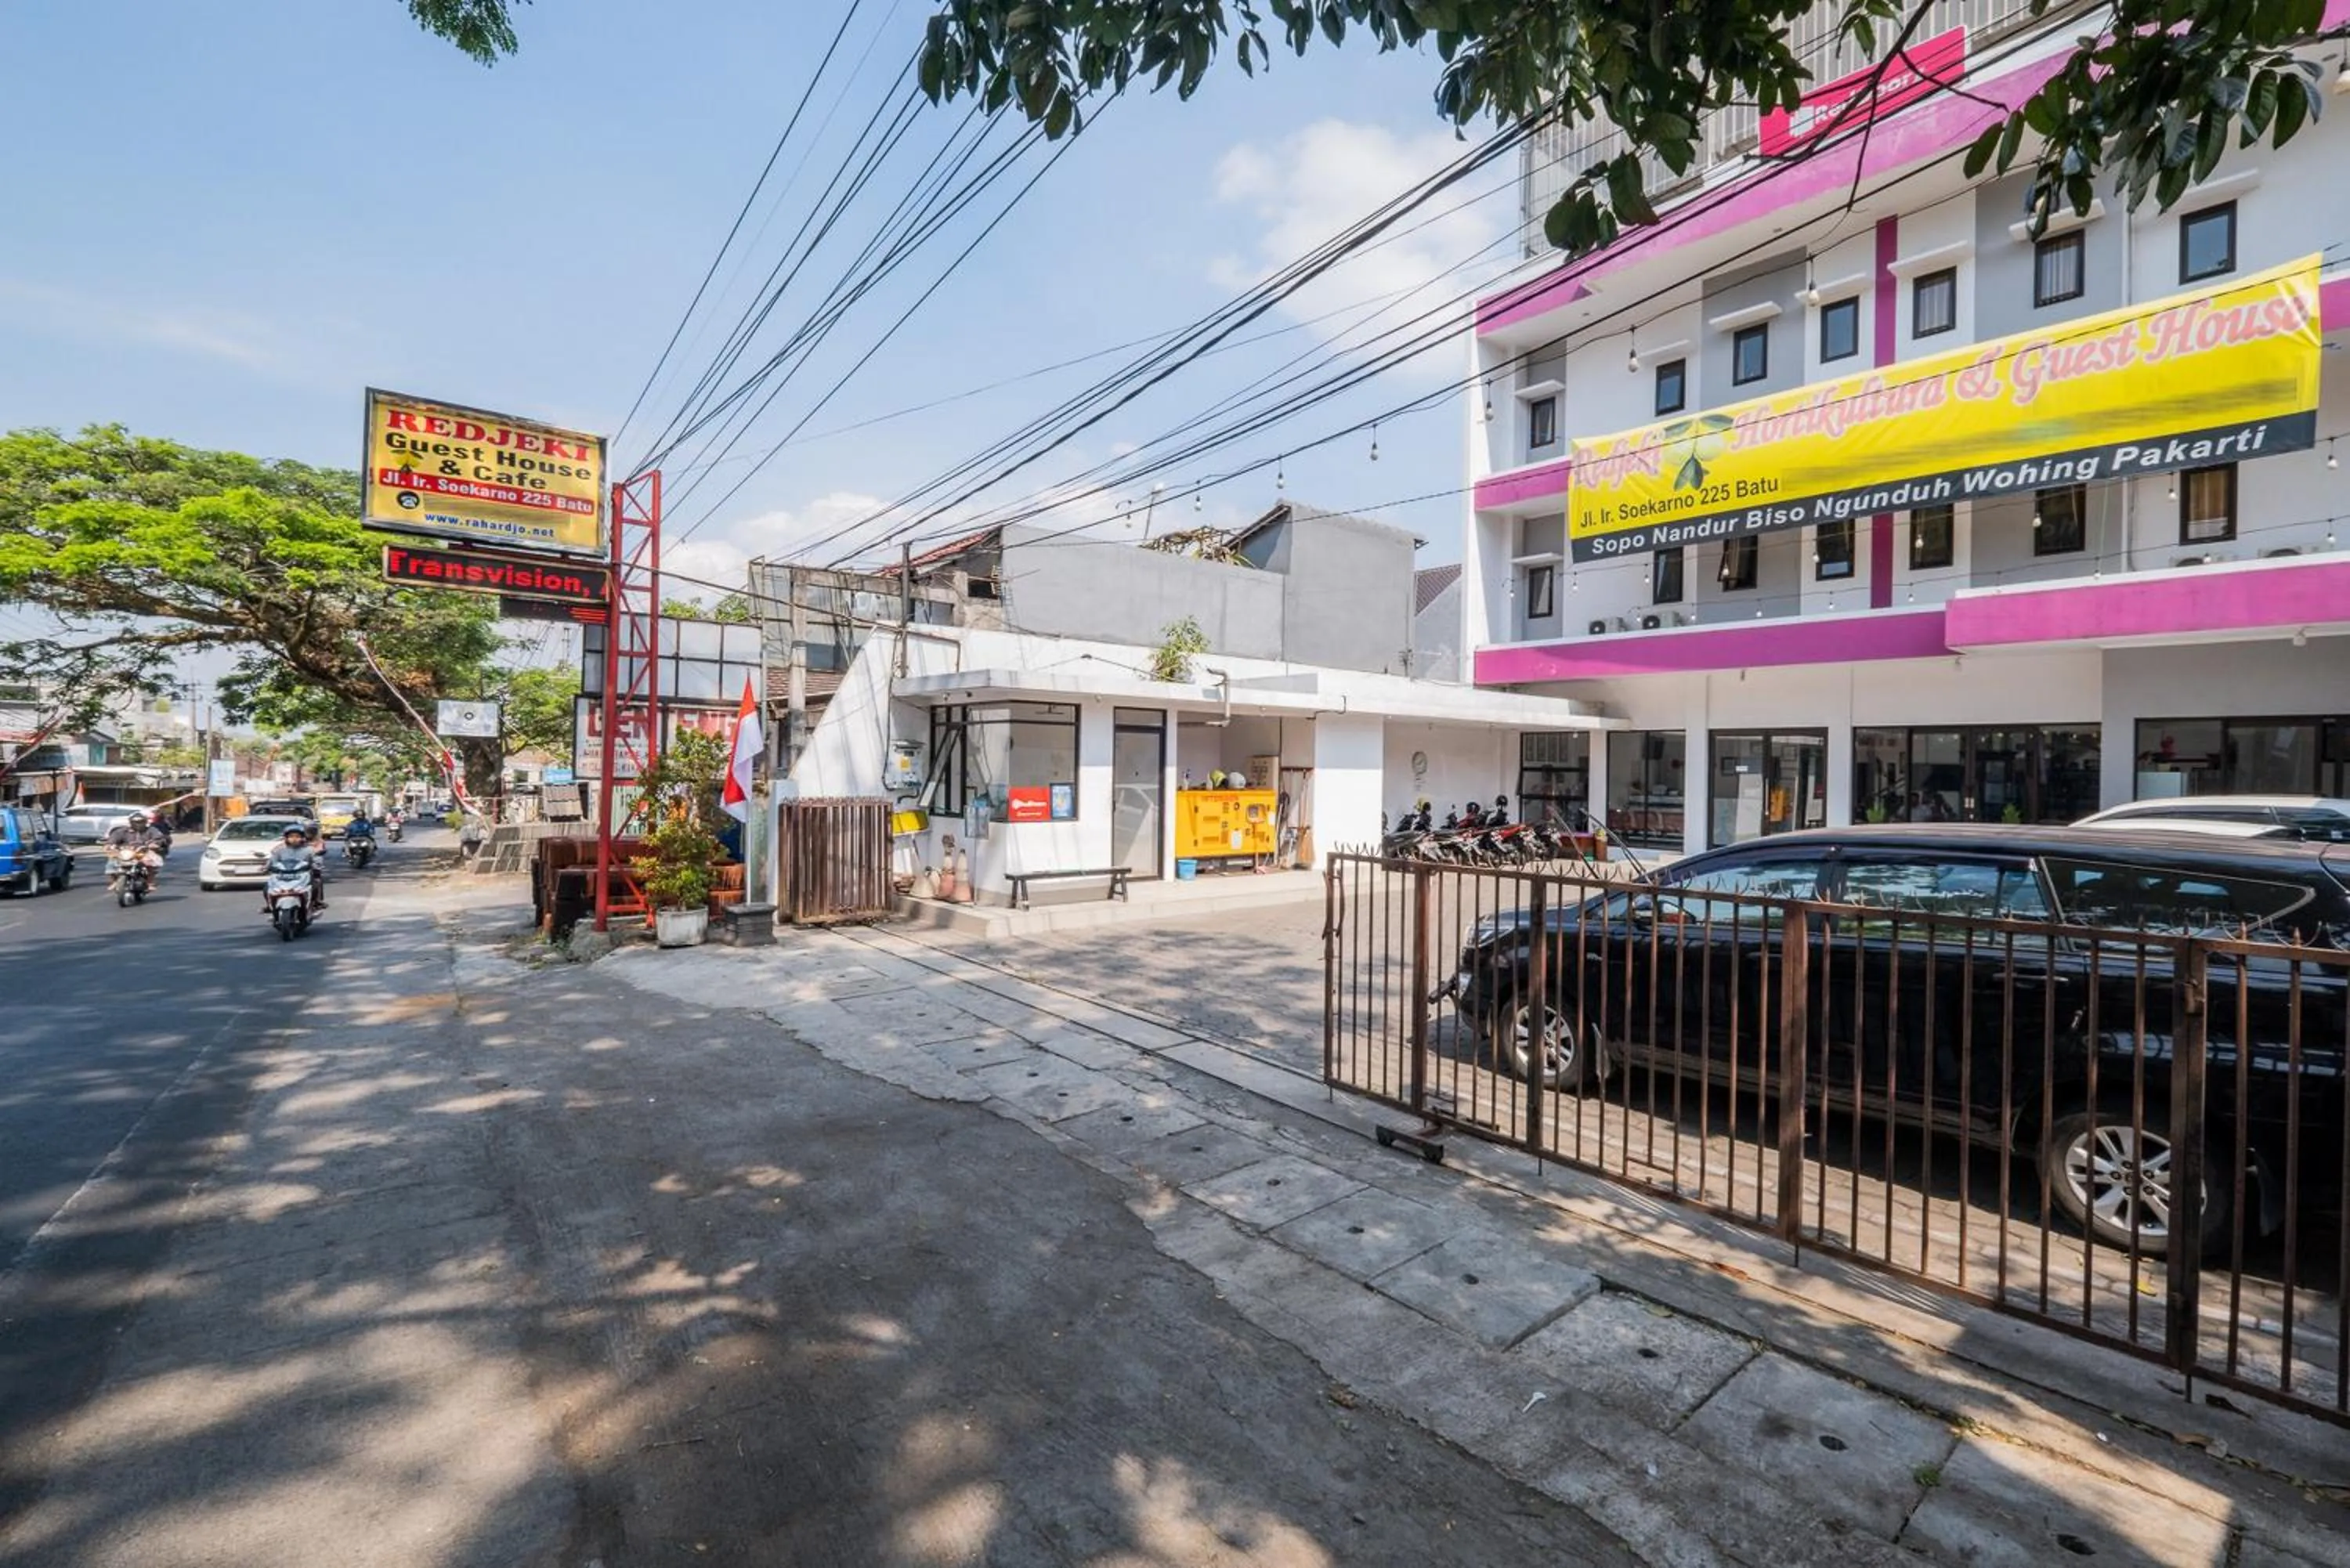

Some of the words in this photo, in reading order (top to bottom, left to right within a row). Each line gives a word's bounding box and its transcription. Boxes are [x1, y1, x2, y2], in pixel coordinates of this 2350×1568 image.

[1730, 375, 1948, 452] Hortikultura
[1957, 345, 2002, 400] &
[2012, 320, 2138, 405] Guest
[2145, 294, 2308, 363] House
[385, 432, 484, 462] Guest
[496, 450, 591, 480] House
[387, 410, 588, 461] REDJEKI
[382, 471, 406, 485] Jl.
[413, 475, 431, 489] Ir.
[438, 479, 518, 500] Soekarno
[522, 491, 551, 507] 225
[557, 497, 591, 512] Batu
[439, 459, 461, 475] &
[474, 465, 546, 489] Cafe
[1592, 533, 1645, 555] Sopo
[1652, 517, 1739, 544] Nandur
[1745, 504, 1806, 529] Biso
[1813, 478, 1952, 518] Ngunduh
[1963, 456, 2099, 493] Wohing
[2111, 425, 2267, 471] Pakarti
[425, 513, 555, 537] www.rahardjo.net
[1580, 511, 1597, 528] Jl.
[1600, 508, 1614, 523] Ir.
[1618, 495, 1695, 520] Soekarno
[1699, 486, 1730, 505] 225
[1736, 477, 1779, 498] Batu
[389, 551, 591, 598] Transvision,
